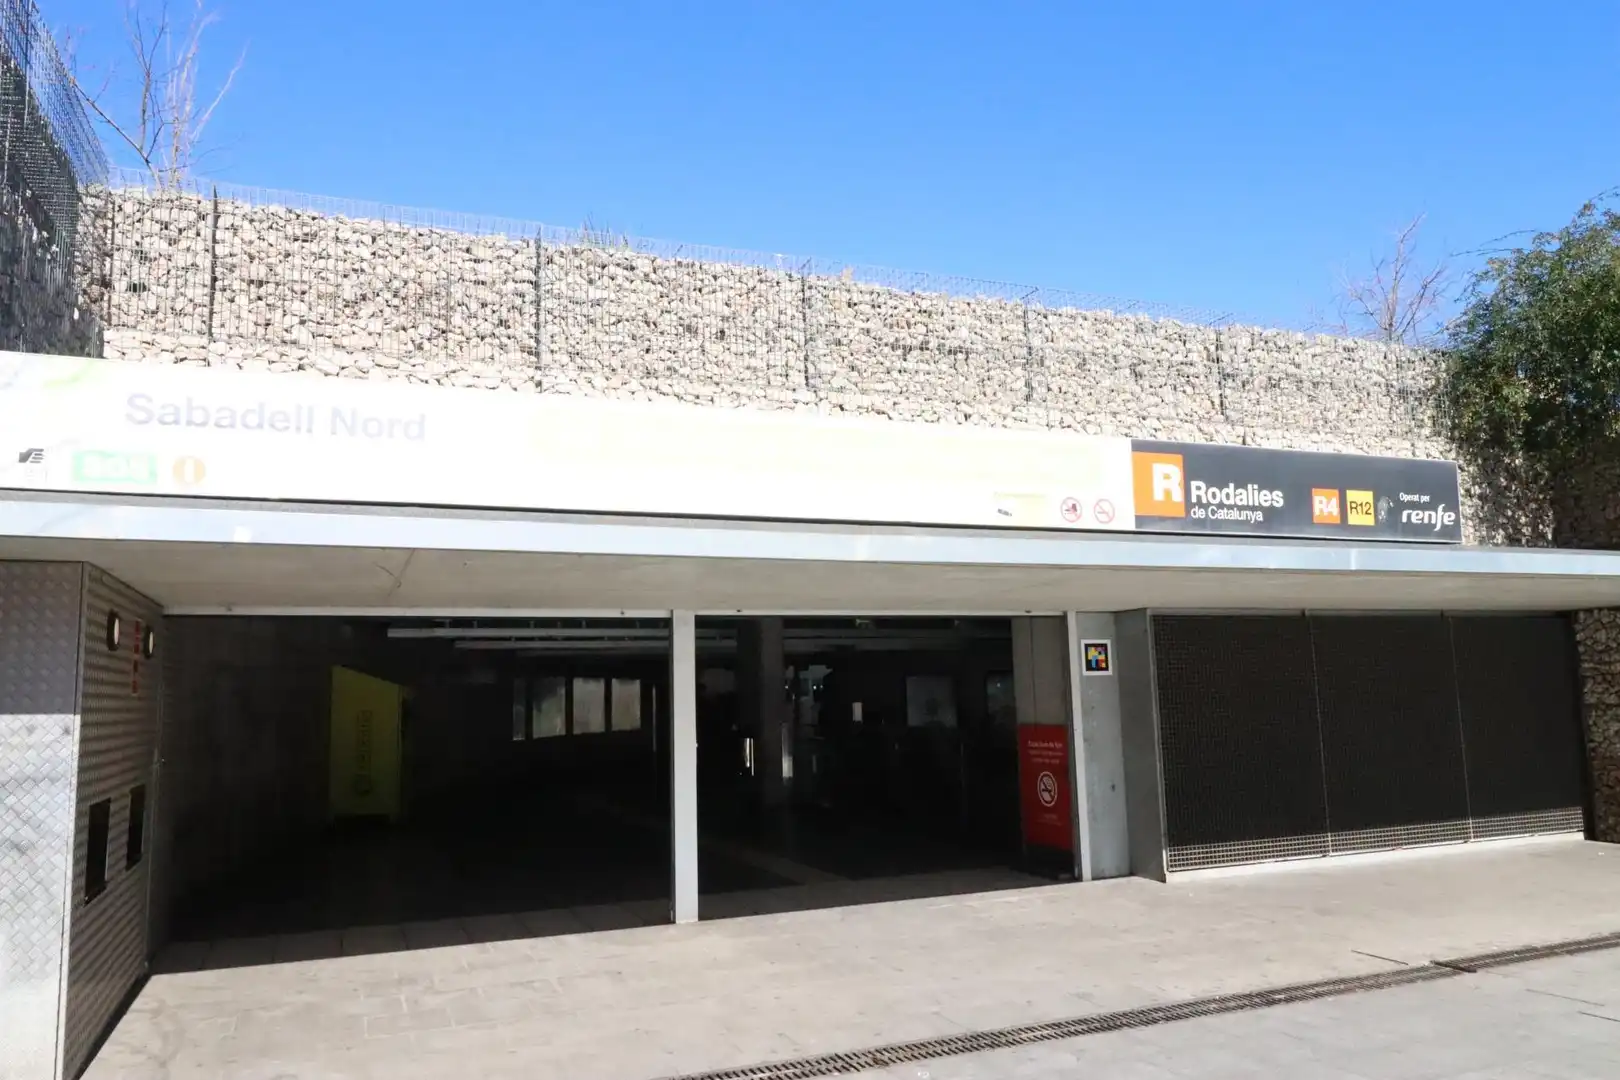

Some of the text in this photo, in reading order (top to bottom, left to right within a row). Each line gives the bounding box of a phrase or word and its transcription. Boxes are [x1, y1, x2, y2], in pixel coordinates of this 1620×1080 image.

[125, 392, 426, 442] Sabadell Nord
[1152, 462, 1185, 503] R
[1190, 480, 1285, 508] Rodalies
[1313, 495, 1339, 517] R4
[1349, 500, 1373, 516] R12
[1399, 492, 1430, 503] Operat per
[1190, 506, 1264, 523] de Catalunya
[1402, 503, 1456, 532] renfe
